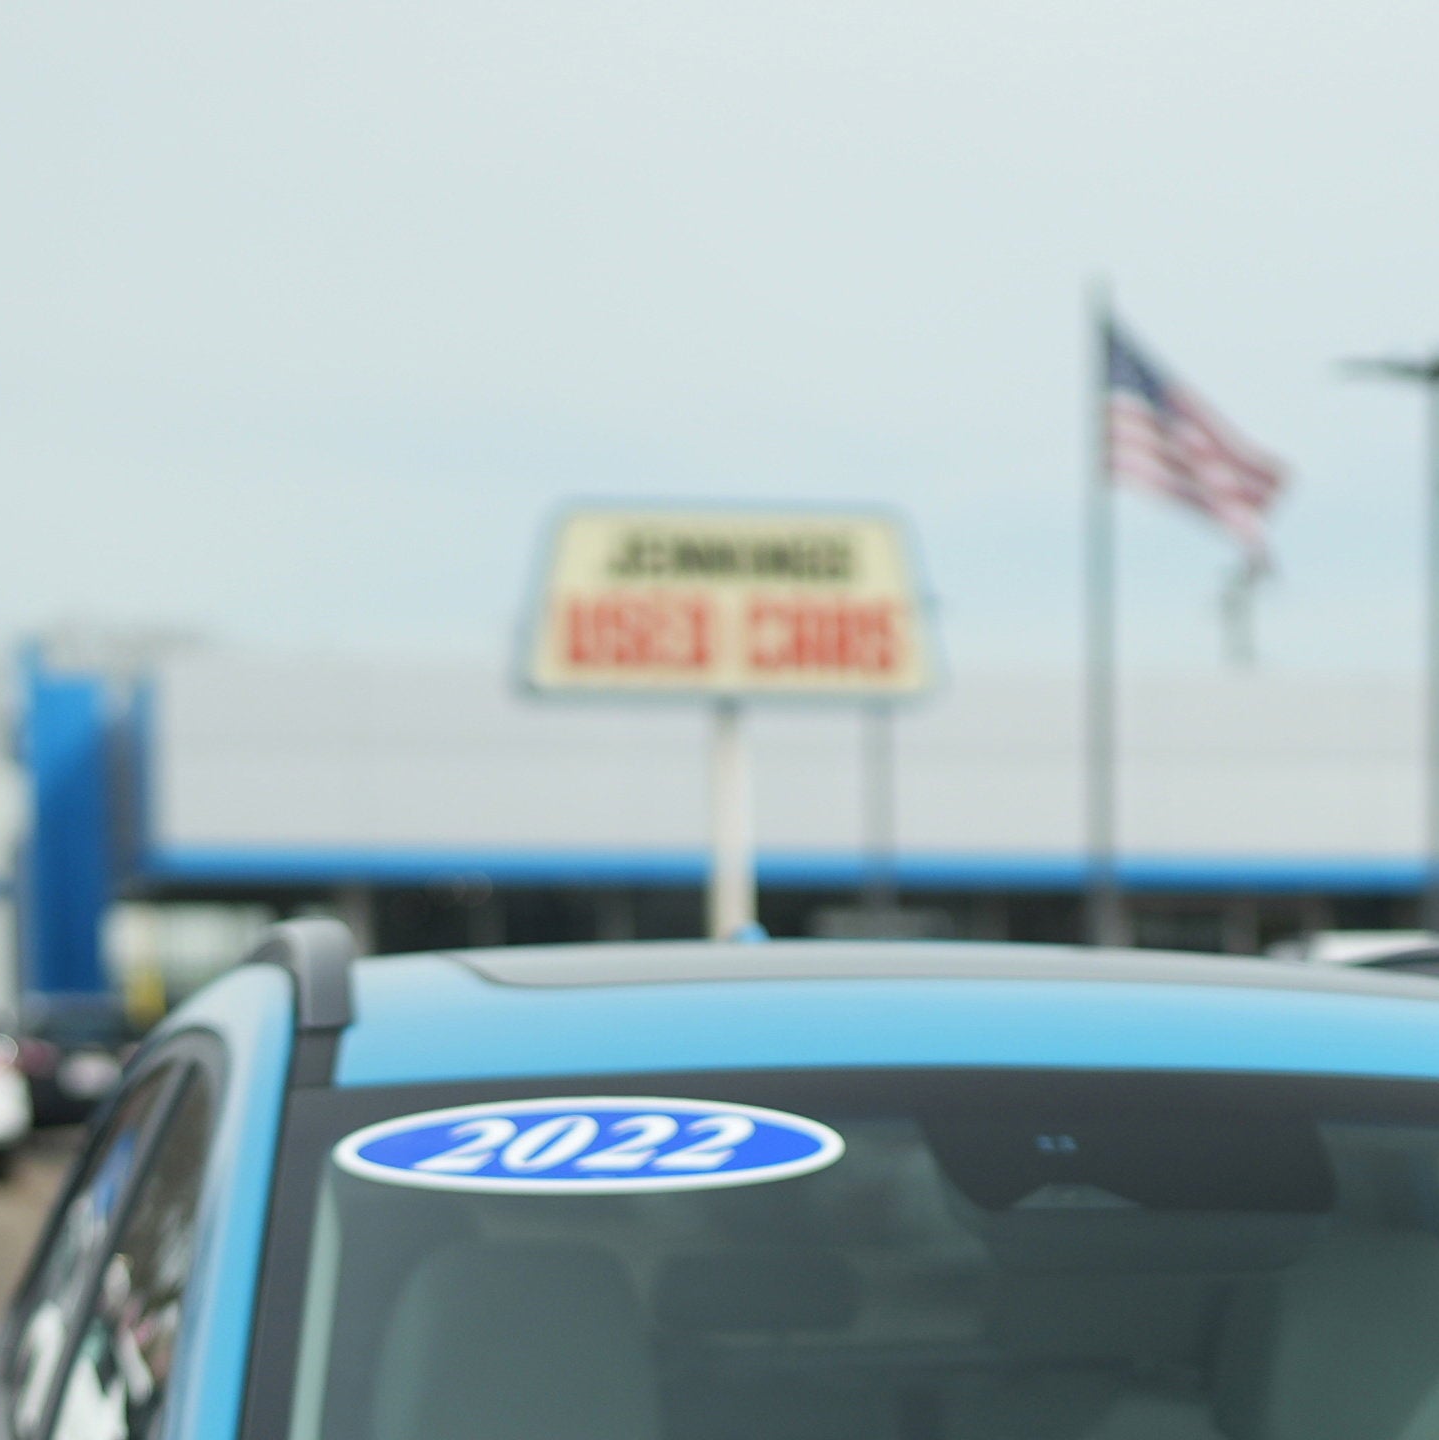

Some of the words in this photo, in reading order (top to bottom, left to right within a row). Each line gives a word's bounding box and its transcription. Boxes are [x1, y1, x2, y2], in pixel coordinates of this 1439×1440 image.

[560, 598, 713, 668] USED
[741, 598, 900, 670] CARS
[412, 1114, 756, 1174] 2022
